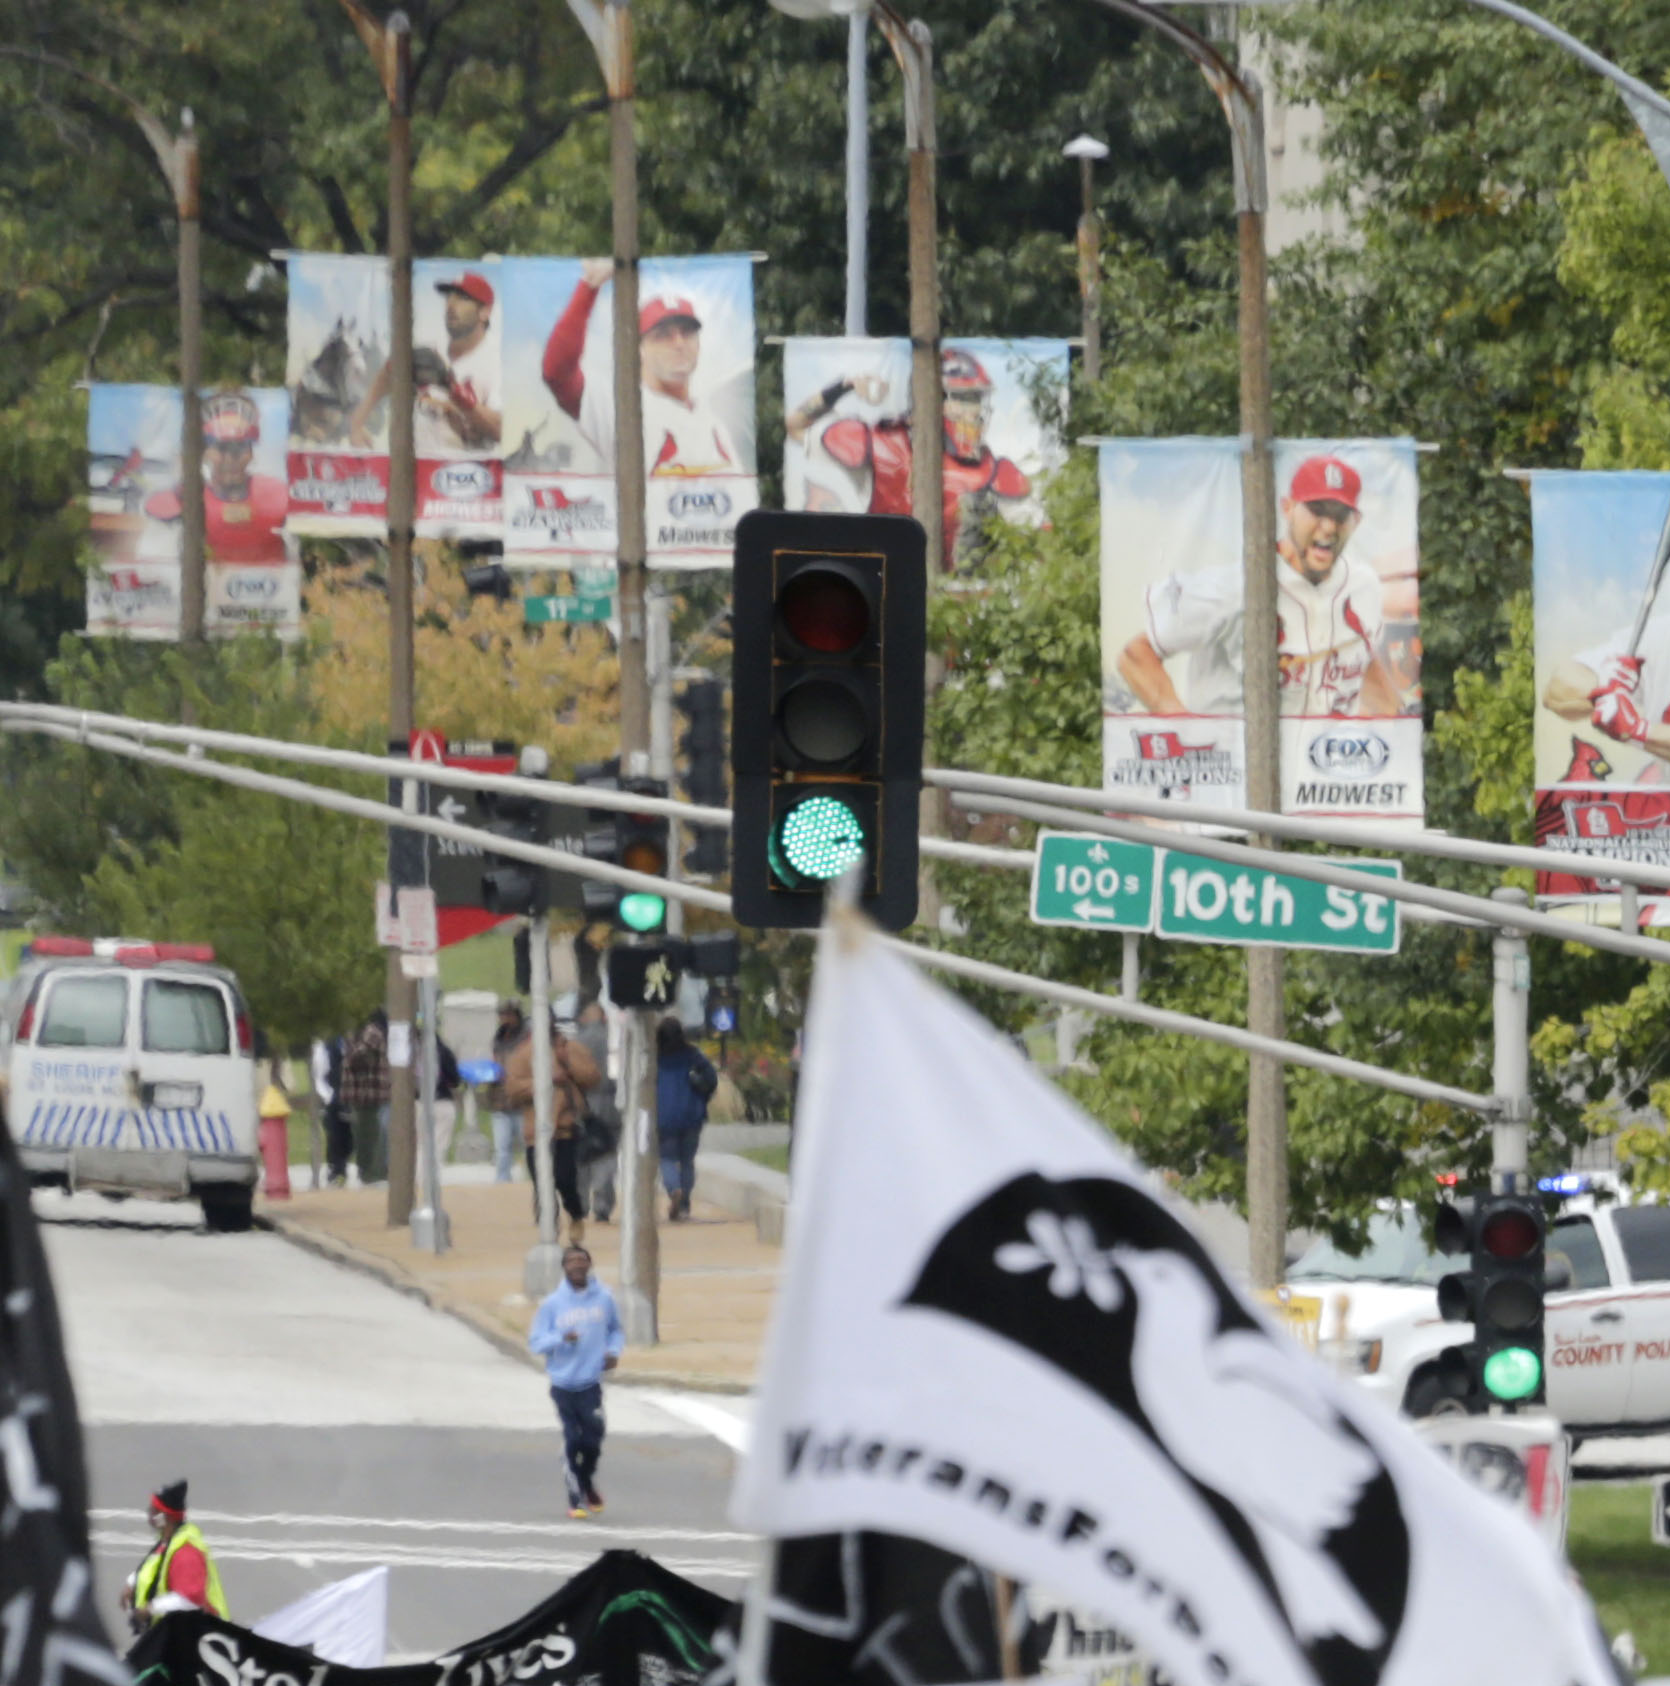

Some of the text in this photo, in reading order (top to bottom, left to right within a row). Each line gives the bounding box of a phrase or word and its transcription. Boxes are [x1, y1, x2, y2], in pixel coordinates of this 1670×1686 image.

[657, 526, 738, 547] MIDWES
[1325, 738, 1372, 758] FOX
[1295, 783, 1409, 805] MIDWEST
[1054, 864, 1120, 898] 100
[1168, 867, 1388, 934] 10th St
[31, 1061, 121, 1081] SHERIFF
[1551, 1342, 1626, 1368] COUNTY
